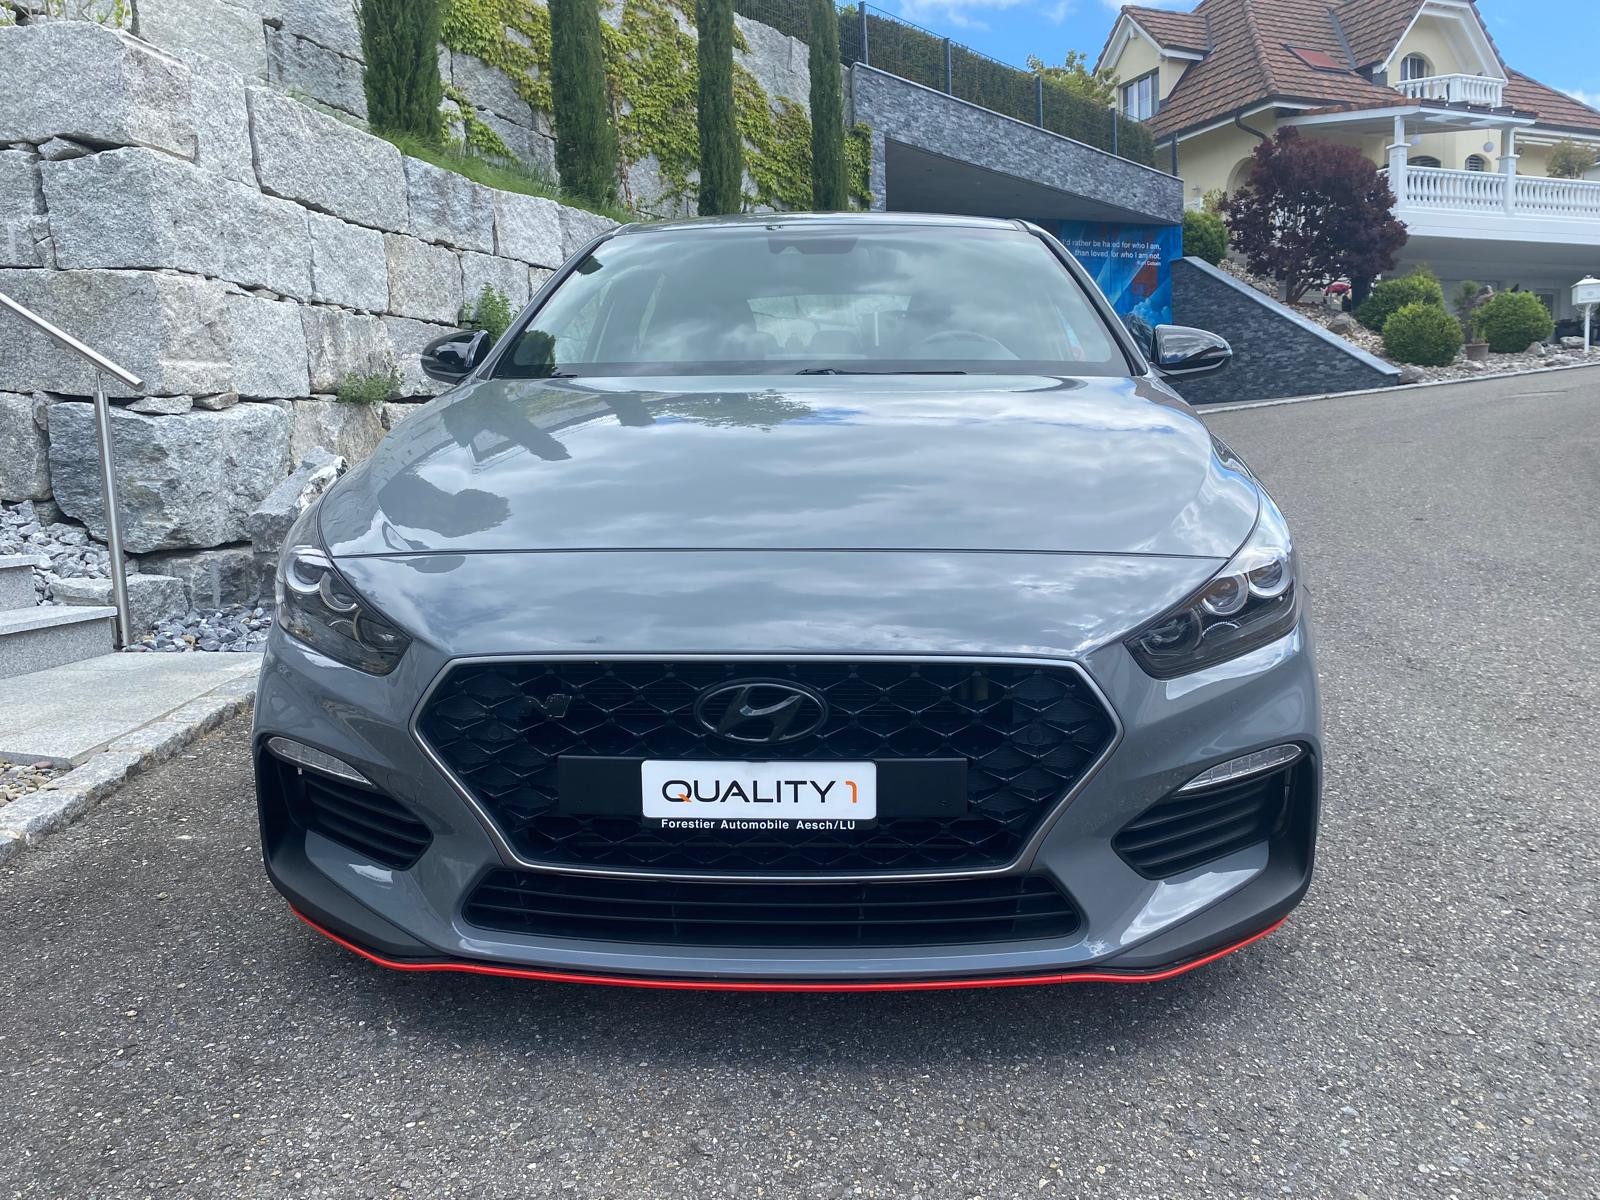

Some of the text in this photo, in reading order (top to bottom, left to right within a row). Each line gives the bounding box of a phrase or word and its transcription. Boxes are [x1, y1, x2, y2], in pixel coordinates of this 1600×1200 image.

[1072, 239, 1091, 247] rather
[1121, 240, 1130, 248] for
[1132, 241, 1145, 249] who
[1090, 249, 1109, 257] loved
[1120, 250, 1134, 258] who
[661, 779, 836, 804] QUALITY
[661, 818, 856, 831] Forestier Automobile Aesch/LU
